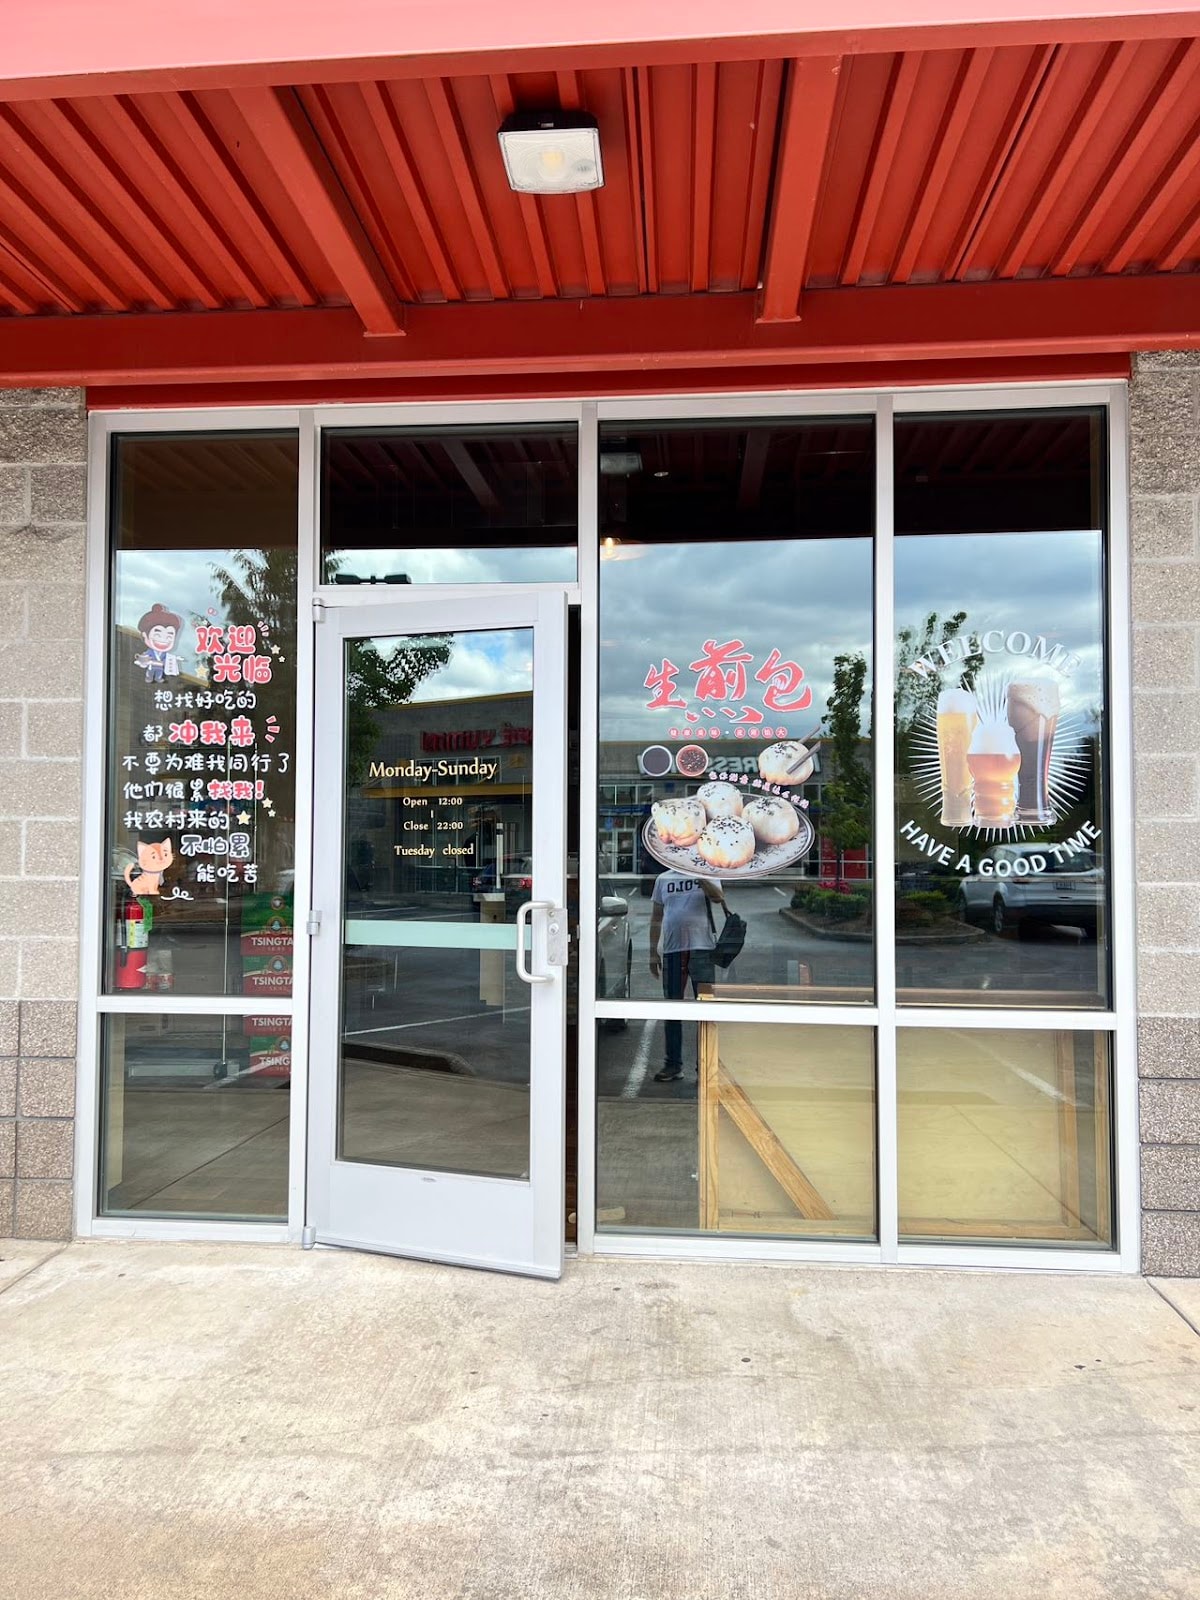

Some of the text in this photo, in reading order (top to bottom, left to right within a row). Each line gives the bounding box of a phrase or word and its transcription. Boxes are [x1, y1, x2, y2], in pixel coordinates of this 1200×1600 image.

[195, 625, 256, 654] 欢迎
[907, 630, 1083, 678] WELCOME
[213, 653, 272, 684] 光临
[643, 639, 812, 724] 生煎包
[154, 690, 257, 711] 想找好吃的
[143, 715, 255, 747] 都冲我来
[122, 753, 290, 775] 不要为难我同行了
[369, 757, 497, 782] Monday-Sunday
[402, 797, 463, 807] Open 12:00
[123, 809, 229, 830] 我农村来的
[403, 821, 463, 831] Close 22:00
[180, 833, 250, 857] 不怕累
[394, 843, 474, 858] Tuesday closed
[900, 820, 1102, 877] HAVE A GOOD TIME
[196, 863, 258, 883] 能吃苦
